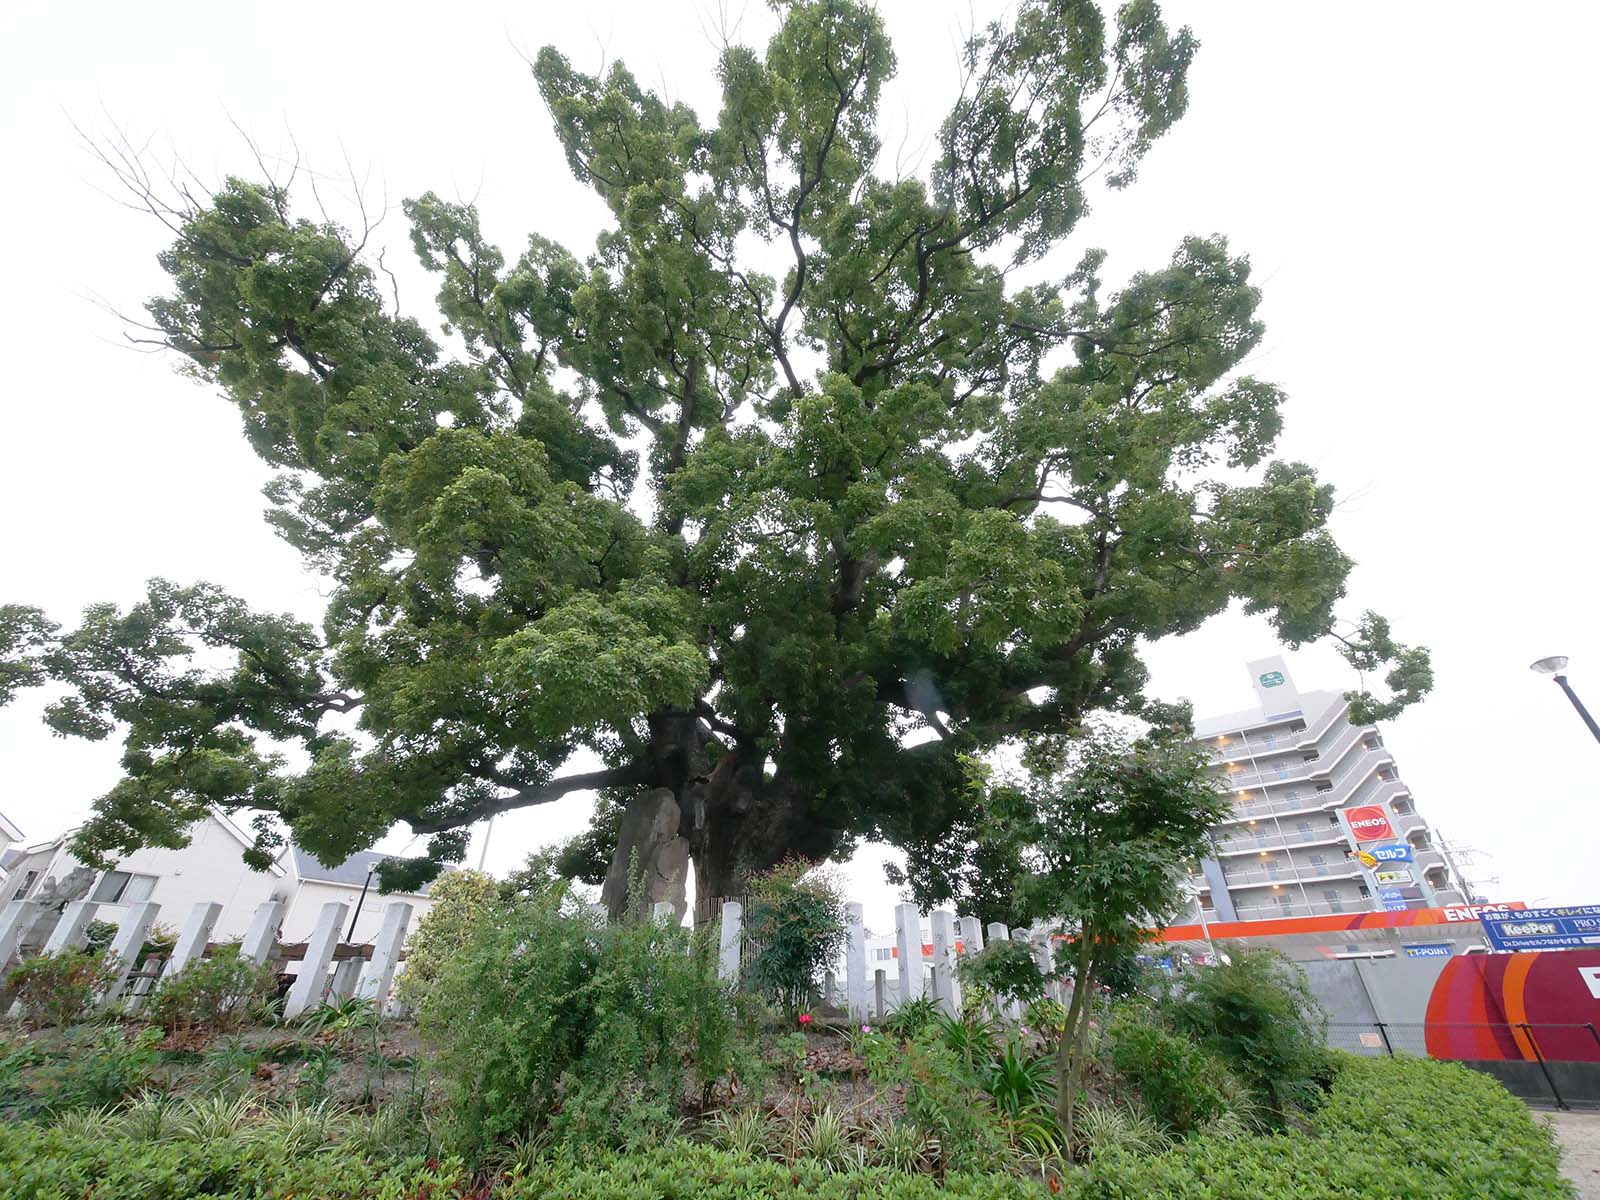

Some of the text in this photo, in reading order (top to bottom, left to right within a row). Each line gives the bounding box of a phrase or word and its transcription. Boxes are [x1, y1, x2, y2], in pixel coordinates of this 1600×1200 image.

[1350, 817, 1387, 829] ENEOS
[1374, 848, 1407, 860] セルフ
[1573, 919, 1596, 927] PRO
[1502, 923, 1555, 936] KeePer
[1414, 947, 1449, 956] T-POINT
